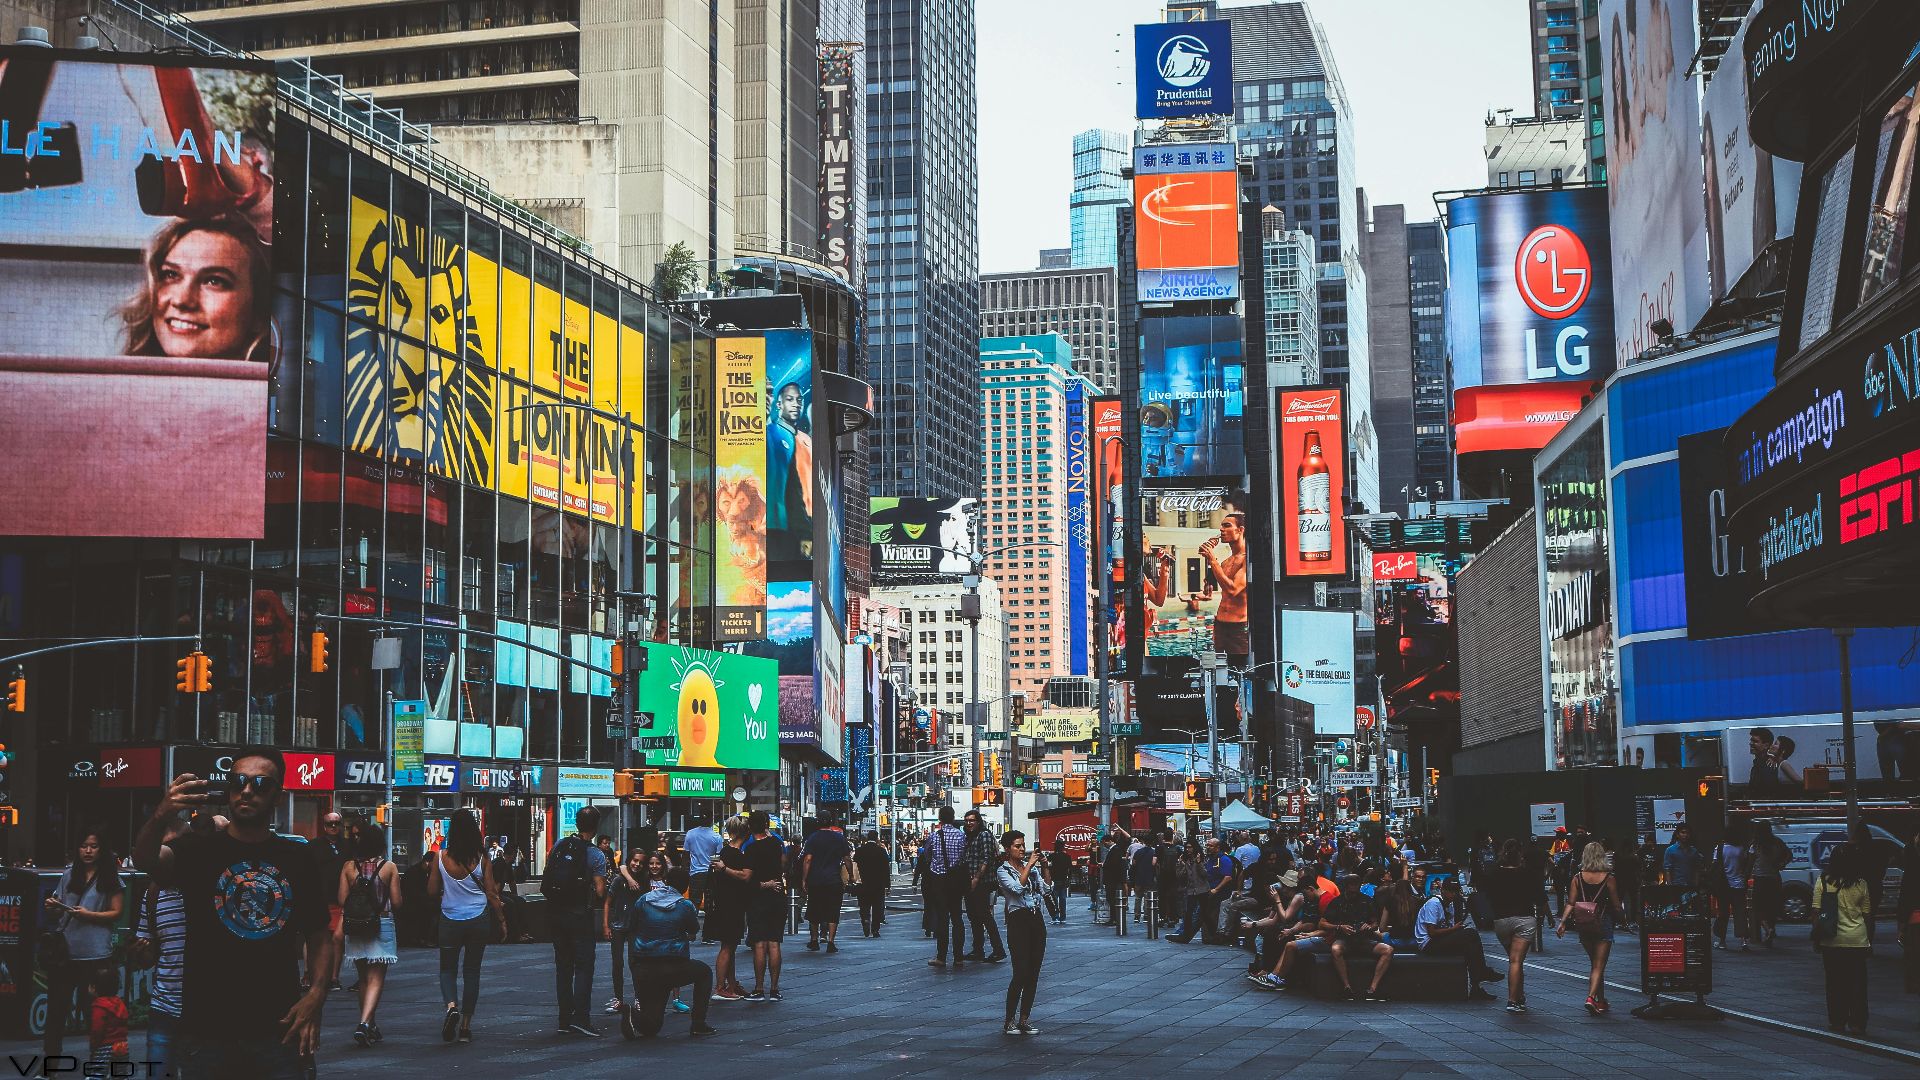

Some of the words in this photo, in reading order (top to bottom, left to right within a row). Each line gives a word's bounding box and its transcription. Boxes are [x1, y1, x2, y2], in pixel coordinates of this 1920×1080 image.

[1156, 88, 1213, 100] Prudential
[92, 123, 242, 166] HAAN
[823, 84, 849, 220] TIMES
[1724, 126, 1739, 158] cher
[1143, 151, 1226, 167] 新华通讯社
[1724, 176, 1744, 214] future
[1159, 274, 1219, 288] XINHUA
[1146, 288, 1181, 299] NEWS
[1183, 286, 1232, 297] AGENCY
[550, 330, 589, 384] THE
[723, 350, 754, 362] Disney
[1525, 325, 1591, 380] LG
[726, 372, 752, 384] THE
[1864, 370, 1885, 400] abc
[721, 387, 758, 409] LION
[1148, 391, 1172, 400] Live
[1175, 388, 1231, 400] beautiful
[508, 367, 571, 465] LION
[1289, 400, 1332, 411] Budweiser
[719, 410, 763, 435] KING
[1766, 387, 1845, 468] campaign
[1067, 395, 1085, 493] NOVOTEL
[533, 485, 559, 501] ENTRANCE
[564, 495, 573, 506] ON
[574, 496, 587, 509] 45TH
[592, 501, 607, 515] STREET
[880, 544, 931, 560] WICKED
[1375, 555, 1414, 575] Ray-Ban
[1547, 589, 1565, 640] OLD
[1565, 570, 1592, 634] NAVY
[1305, 670, 1315, 679] THE
[1315, 670, 1334, 680] GLOBAL
[1334, 671, 1351, 680] GOALS
[743, 712, 768, 741] YOU
[1112, 725, 1119, 734] W
[1122, 725, 1132, 734] 44
[643, 738, 651, 748] W
[654, 738, 665, 748] 44
[69, 771, 97, 779] OAKLEY
[101, 758, 128, 778] Ray-Ban
[297, 758, 325, 786] Ray-Ban
[490, 769, 530, 789] TISST
[672, 778, 688, 791] NEW
[687, 779, 704, 792] YORK
